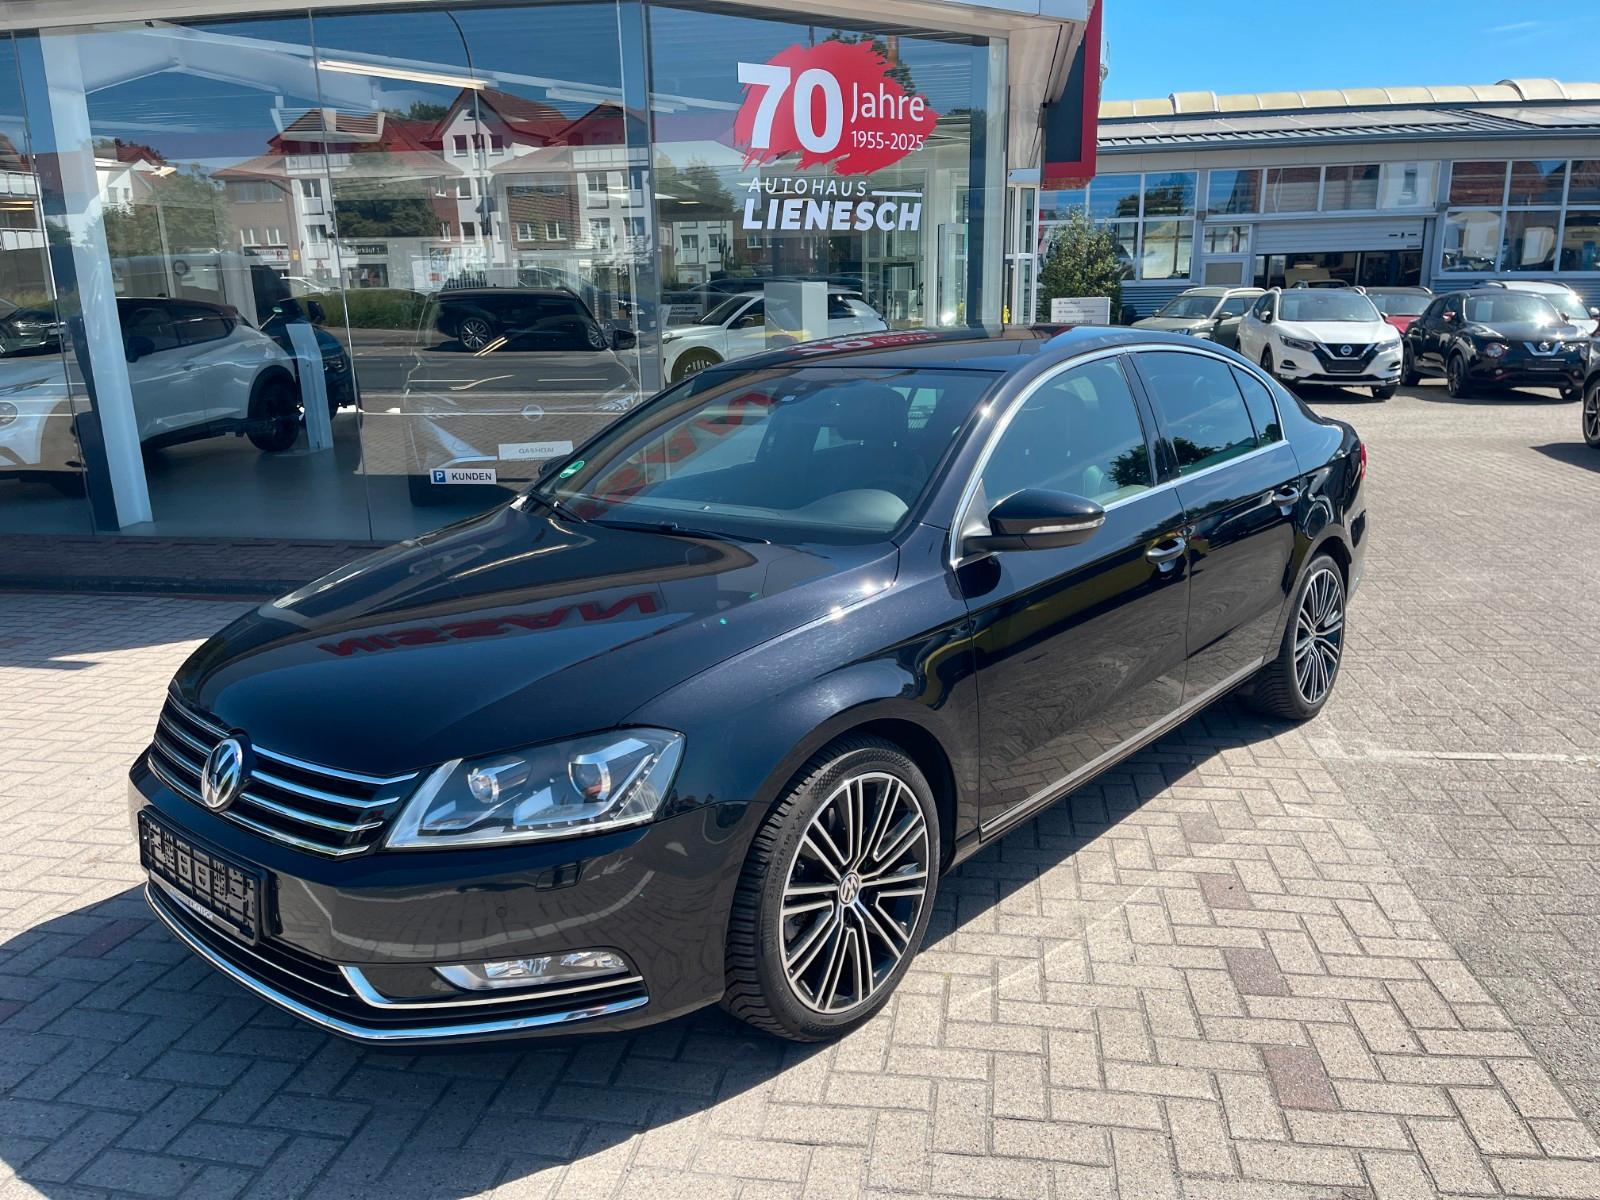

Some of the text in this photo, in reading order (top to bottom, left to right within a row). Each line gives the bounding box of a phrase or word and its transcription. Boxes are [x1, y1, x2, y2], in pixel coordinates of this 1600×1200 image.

[737, 61, 844, 154] 70
[850, 82, 925, 123] Jahre
[850, 130, 924, 151] 1955-2025
[747, 177, 867, 197] AUTOHAUS
[742, 198, 922, 231] LIENESCH
[451, 472, 492, 481] KUNDEN
